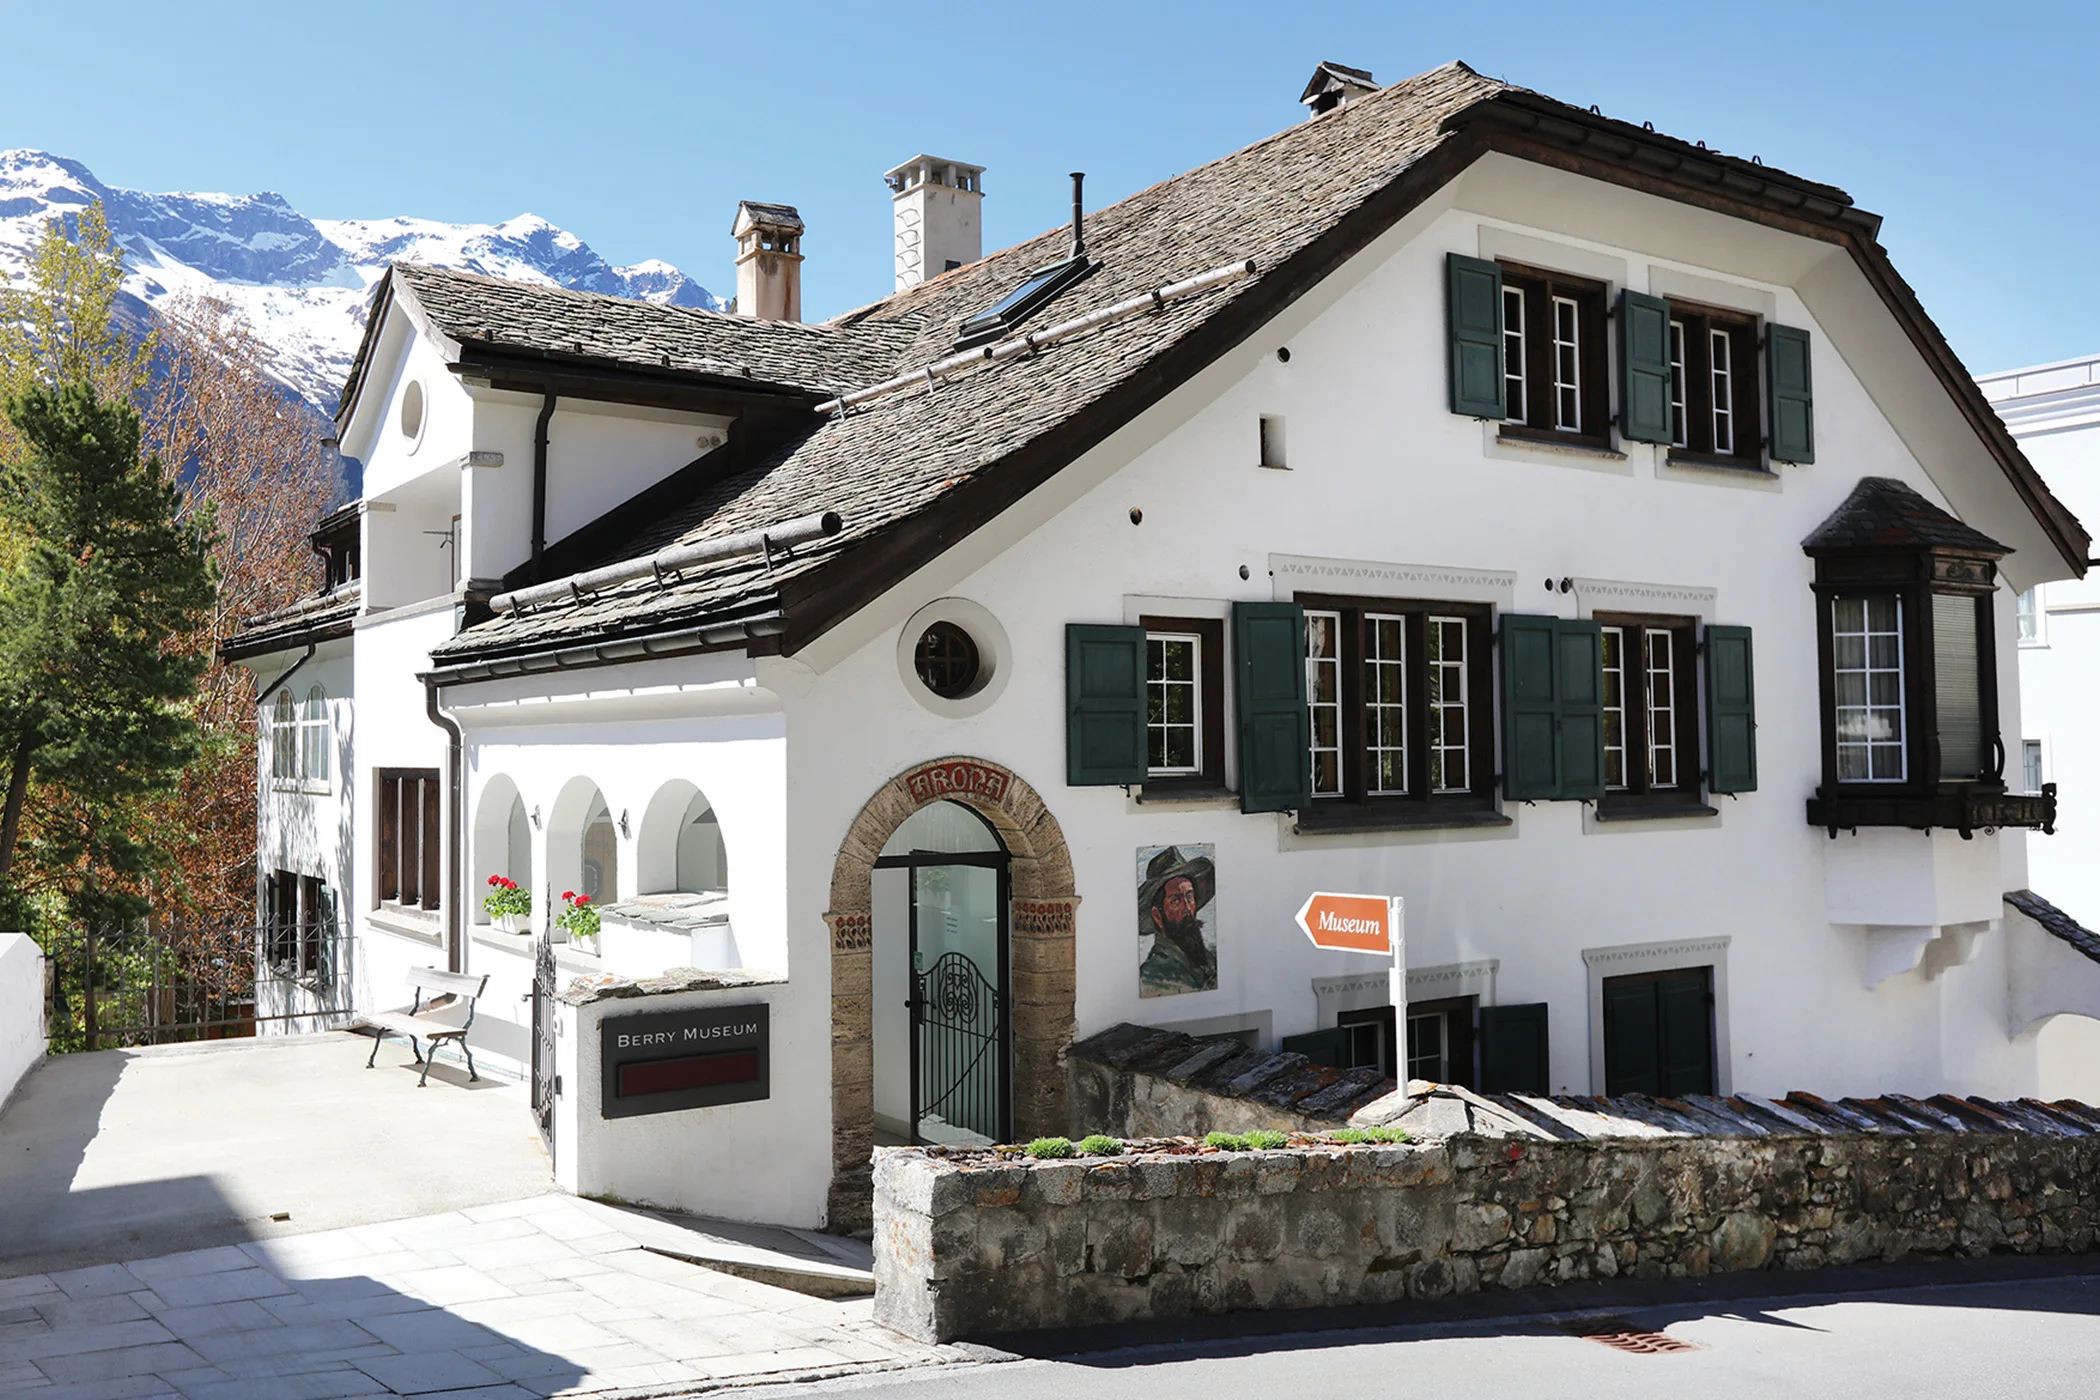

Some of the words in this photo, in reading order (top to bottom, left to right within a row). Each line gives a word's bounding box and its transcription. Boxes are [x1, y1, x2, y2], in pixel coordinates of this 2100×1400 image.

[1318, 910, 1381, 935] Museum
[617, 1031, 676, 1047] BERRY
[683, 1023, 758, 1041] MUSEUM
